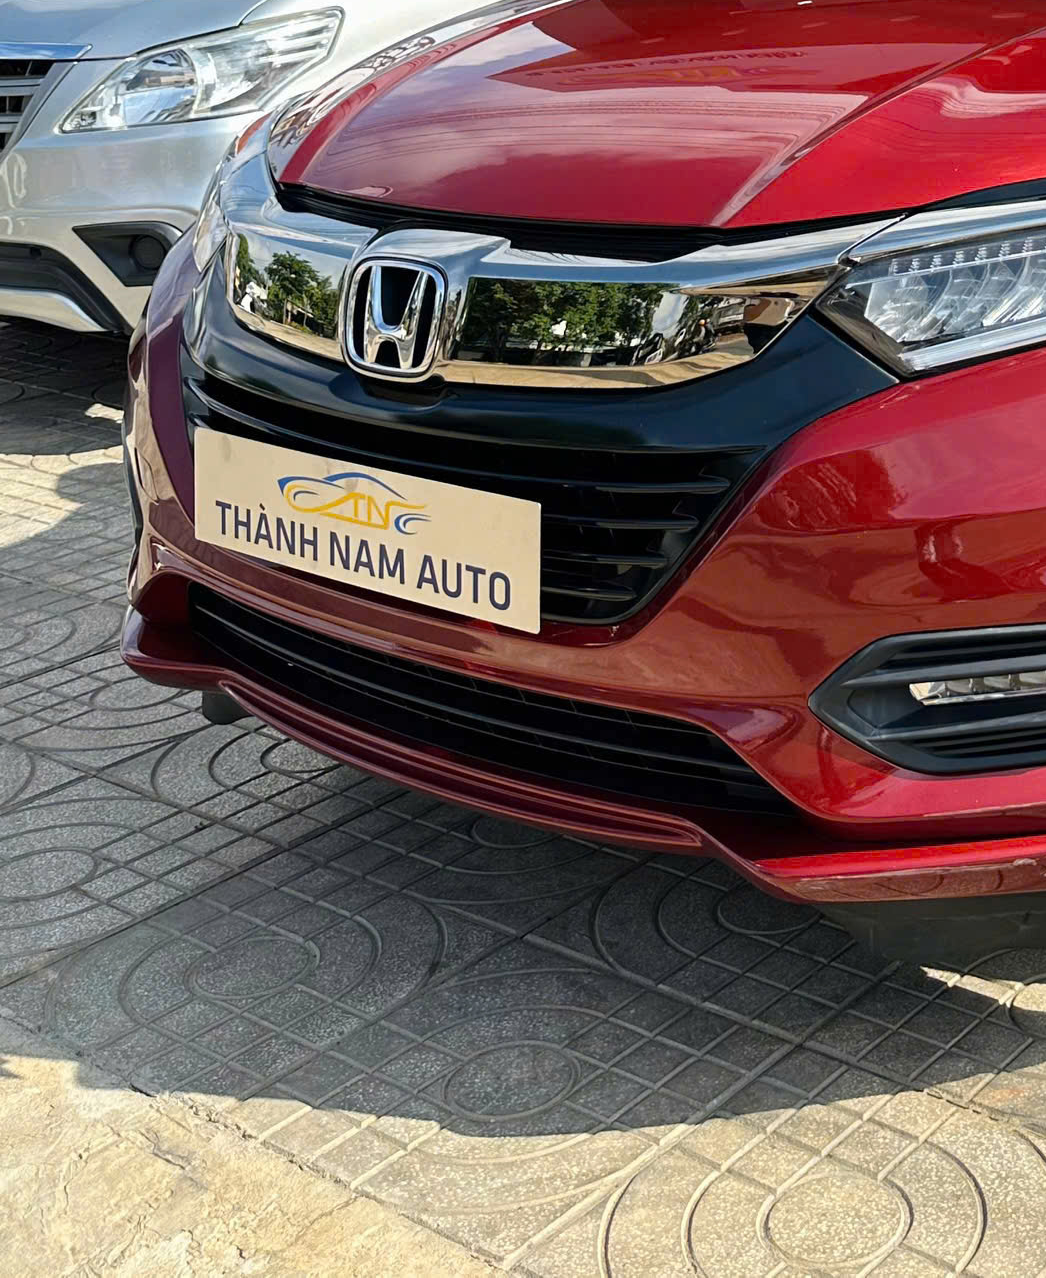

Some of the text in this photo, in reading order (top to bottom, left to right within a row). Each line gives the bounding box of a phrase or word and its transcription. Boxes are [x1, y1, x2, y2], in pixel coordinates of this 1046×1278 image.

[215, 500, 511, 611] THÀNH NAM AUTO
